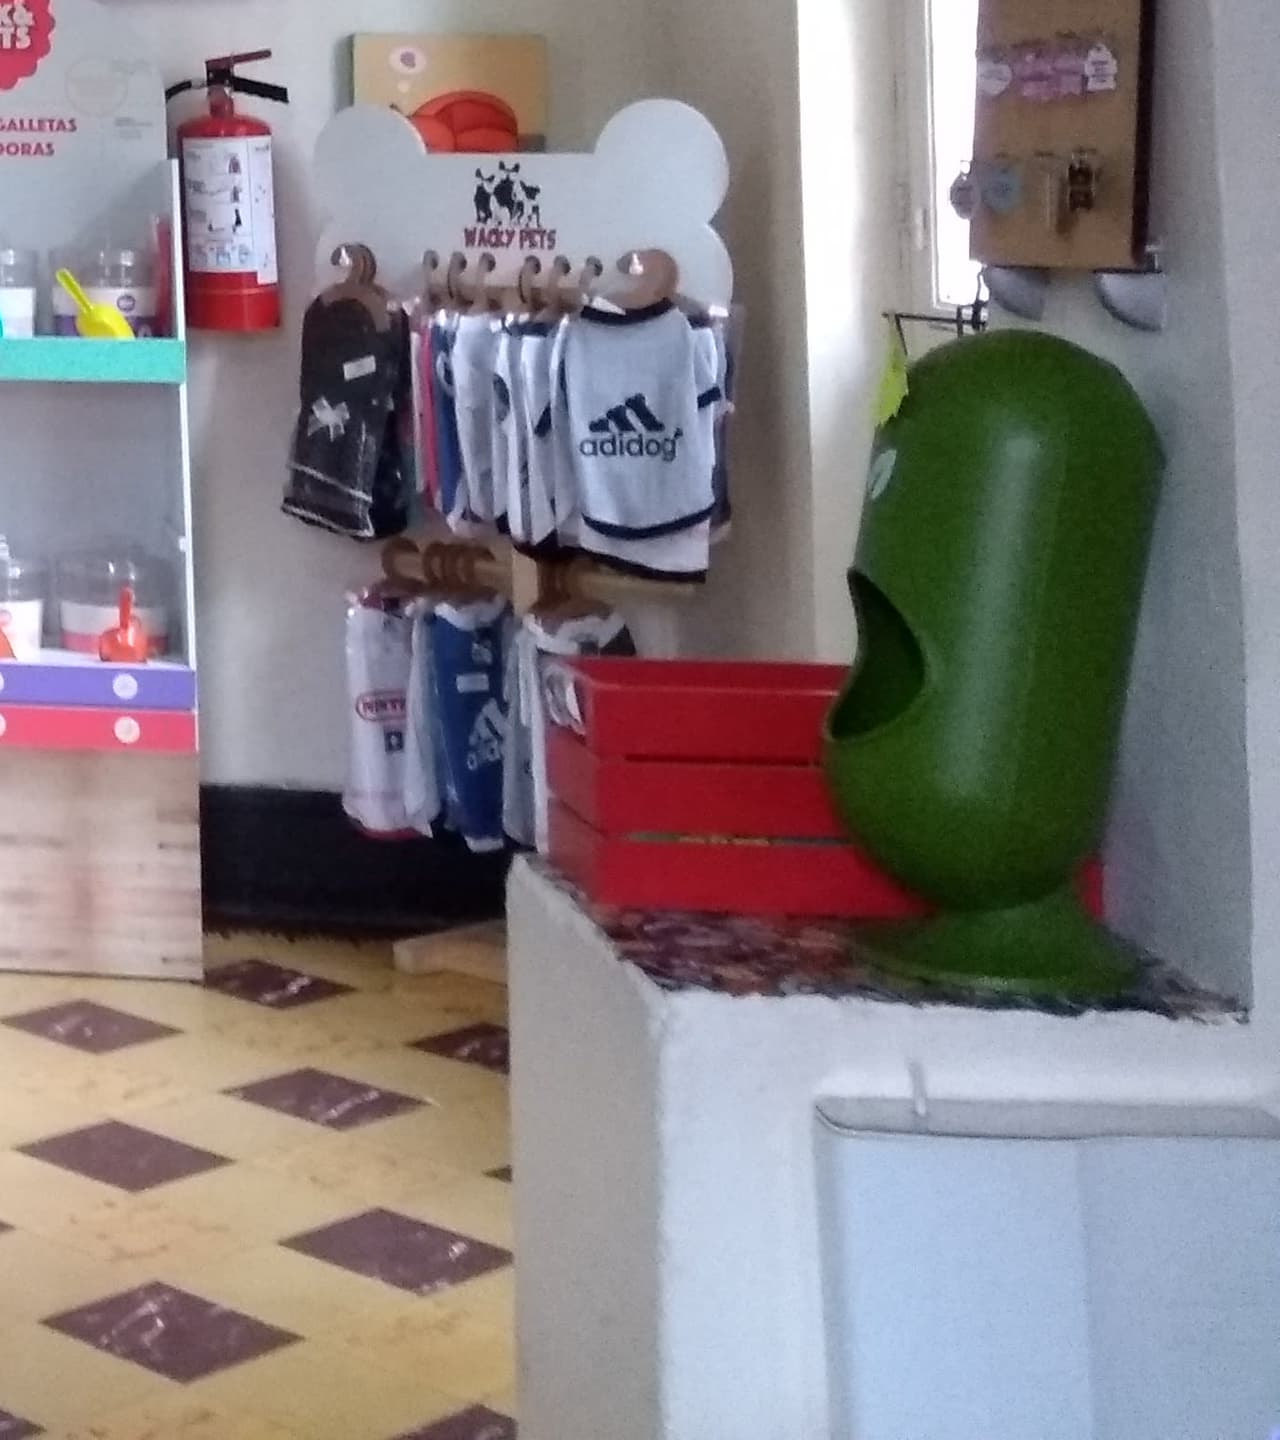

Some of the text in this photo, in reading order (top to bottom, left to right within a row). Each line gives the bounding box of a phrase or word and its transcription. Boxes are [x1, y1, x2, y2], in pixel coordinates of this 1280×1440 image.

[463, 227, 557, 251] WACKY PETS
[579, 432, 677, 463] adidog
